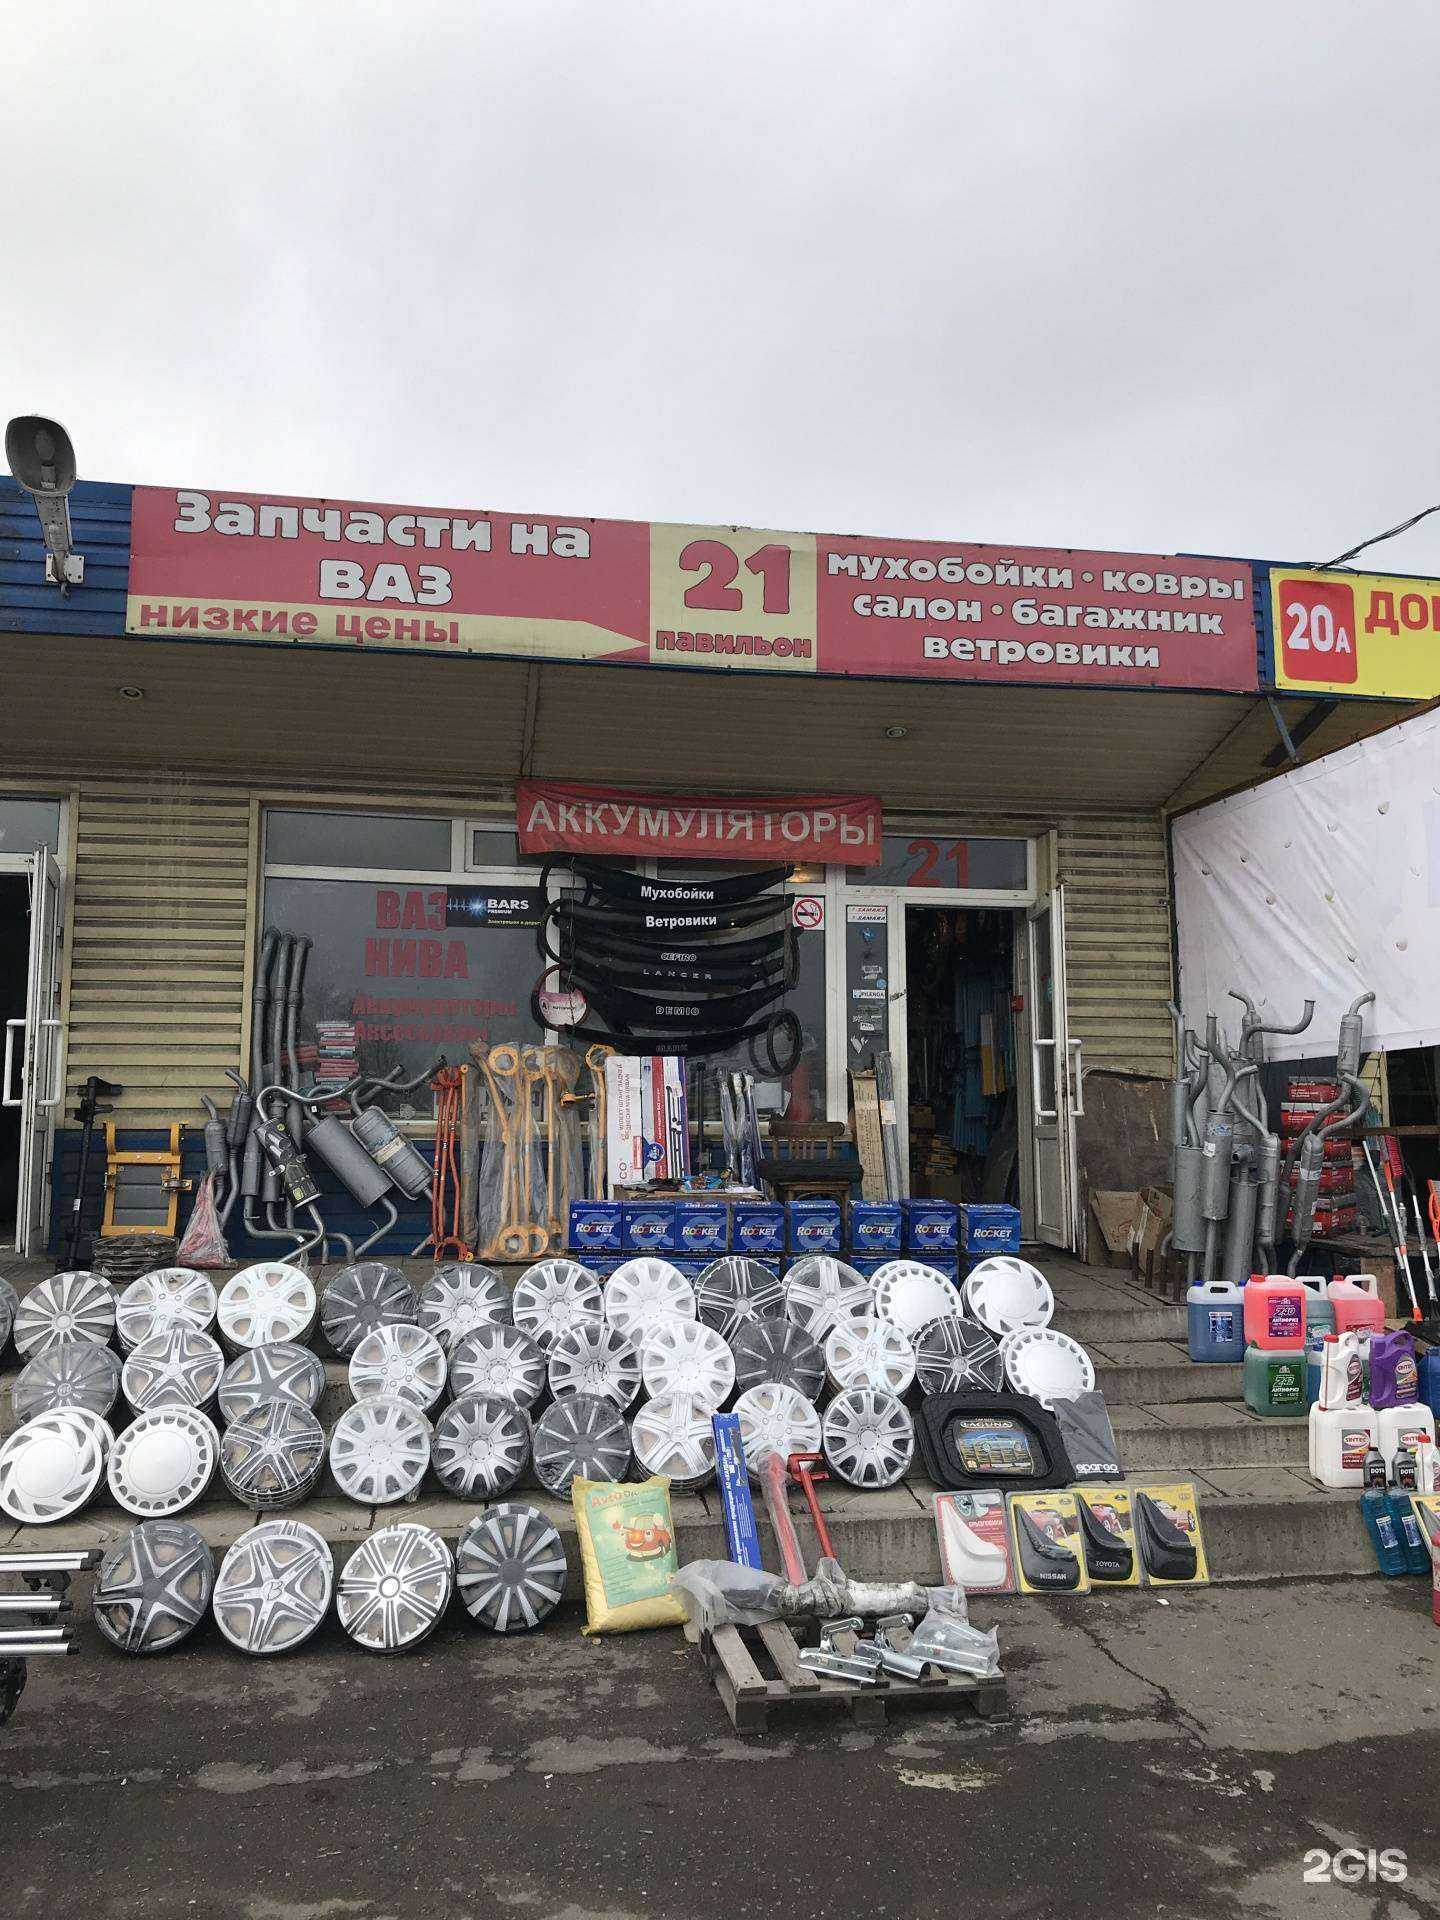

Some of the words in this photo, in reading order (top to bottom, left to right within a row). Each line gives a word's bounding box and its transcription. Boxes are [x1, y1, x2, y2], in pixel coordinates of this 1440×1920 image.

[173, 490, 491, 552] Запчасти
[509, 521, 590, 559] на
[318, 558, 453, 606] ВАЗ
[678, 539, 791, 614] 21
[827, 552, 1074, 590] мухобойки
[1102, 569, 1245, 600] ковры
[140, 603, 318, 638] низкие
[336, 613, 459, 645] цены
[852, 593, 982, 622] салон
[1011, 598, 1226, 635] багажник
[655, 630, 812, 659] павильон
[922, 635, 1160, 668] ветровики
[526, 800, 875, 847] АККУМУЛЯТОРЫ
[907, 839, 969, 889] 21
[375, 890, 448, 931] ВАЗ
[487, 898, 530, 910] BARS
[640, 885, 715, 900] Мухобойки
[645, 915, 717, 930] Ветровики
[364, 937, 470, 978] НИВА
[642, 968, 712, 980] LANCER
[660, 952, 697, 962] CEFIRO
[655, 1005, 700, 1016] DEMIO
[1039, 1572, 1067, 1580] NISSAN
[1095, 1560, 1121, 1568] TOYOTA
